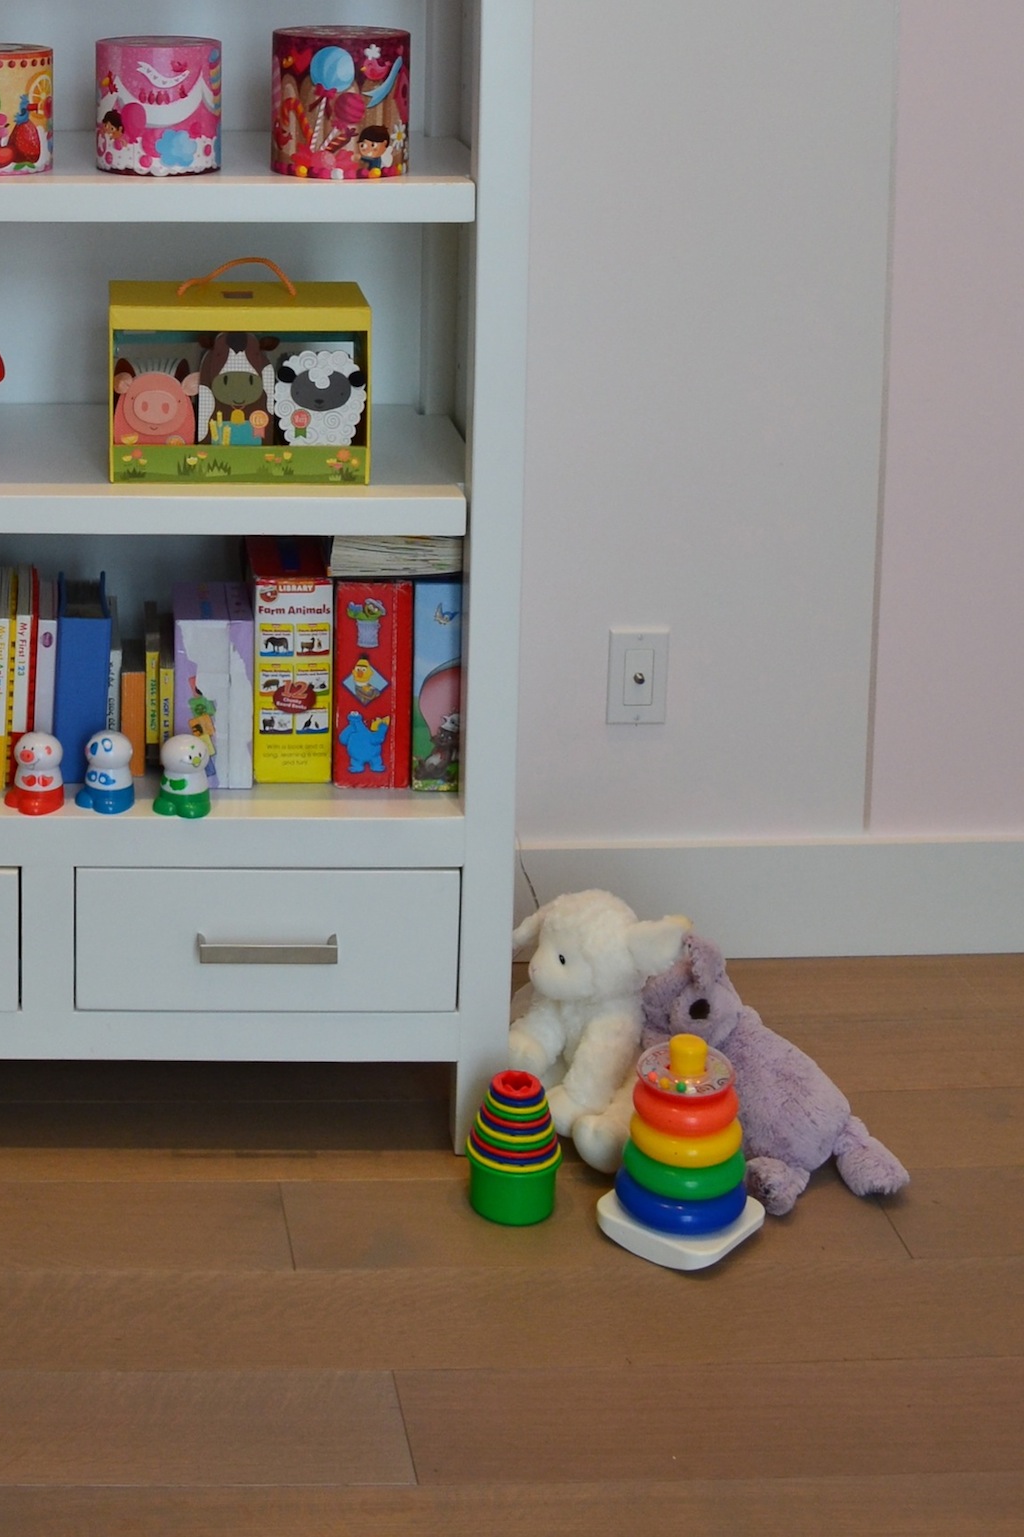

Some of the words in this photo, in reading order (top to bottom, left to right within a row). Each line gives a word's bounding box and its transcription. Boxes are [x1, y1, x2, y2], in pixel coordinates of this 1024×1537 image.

[279, 584, 313, 592] LIBRARY
[258, 605, 286, 615] Farm
[288, 603, 330, 615] Animals
[18, 622, 28, 636] My
[18, 639, 27, 657] First
[281, 680, 308, 699] 12
